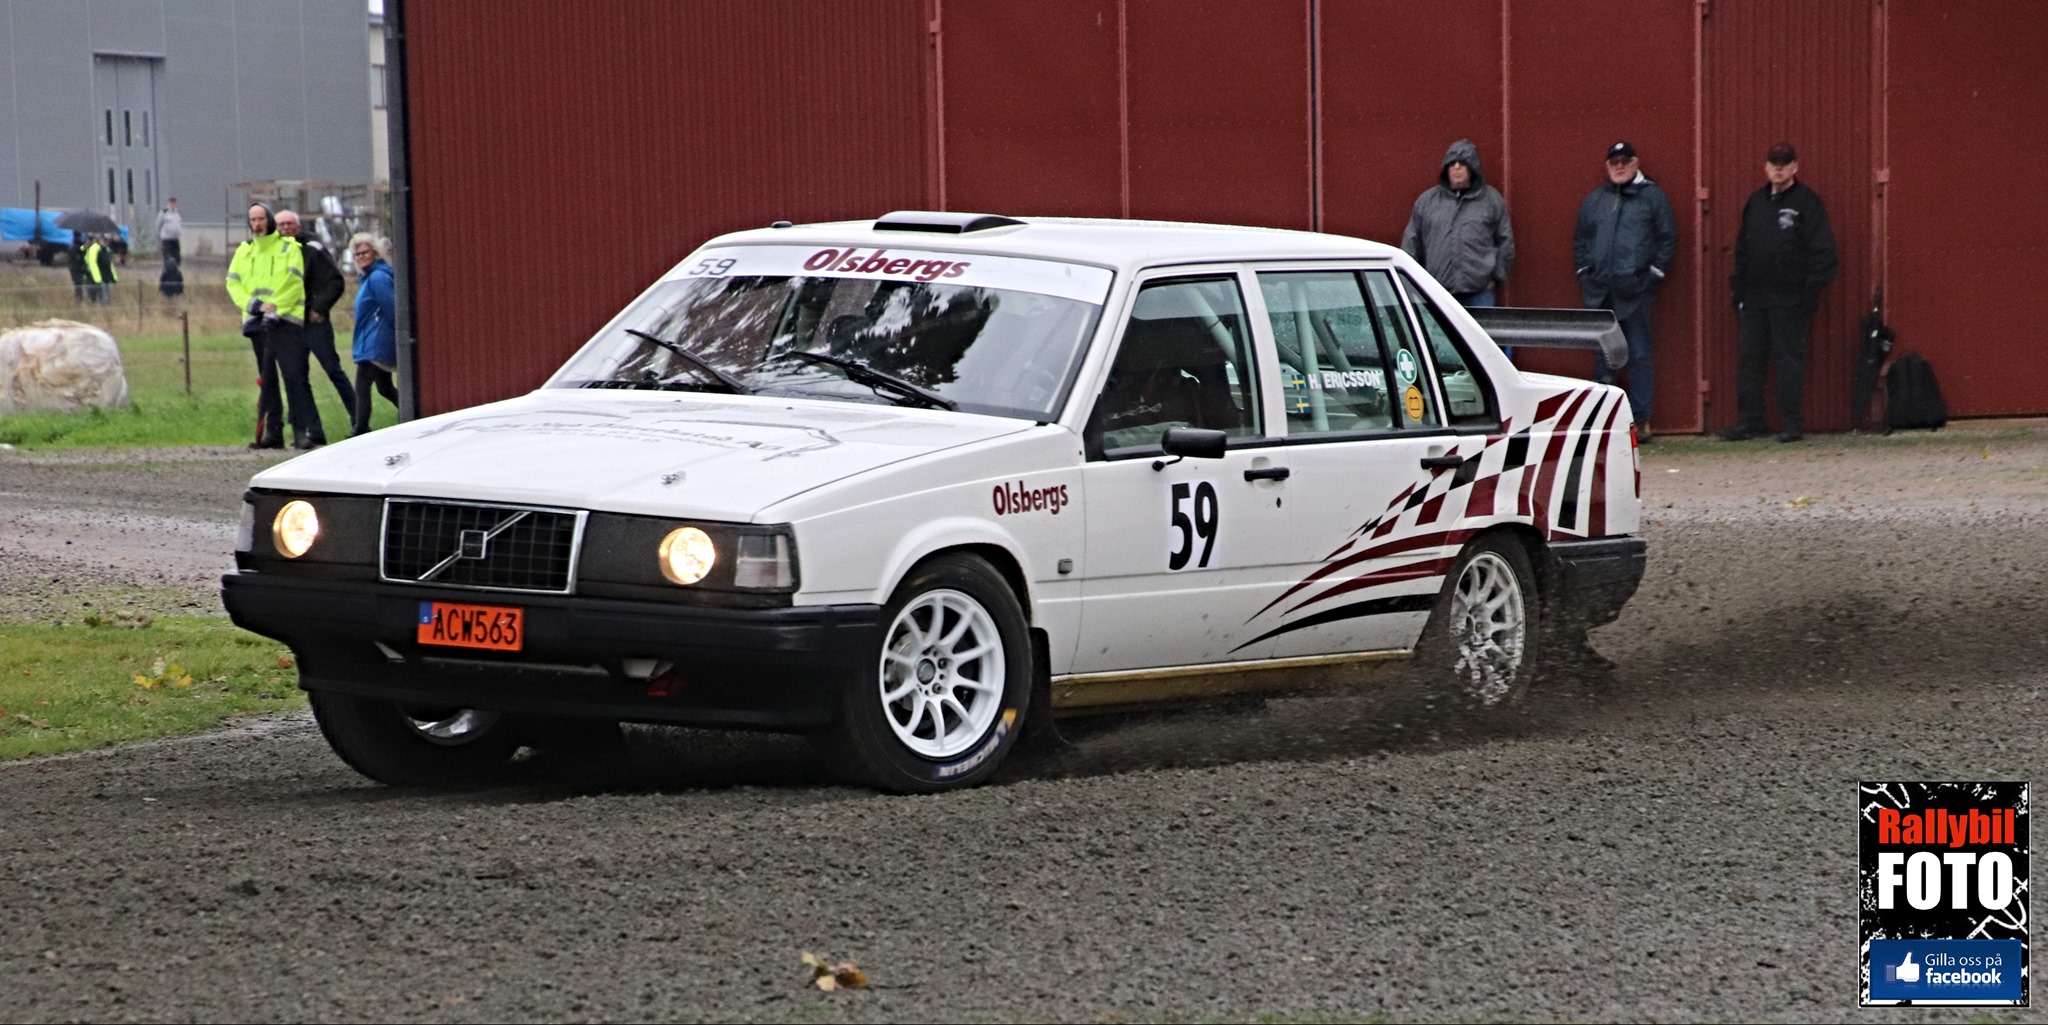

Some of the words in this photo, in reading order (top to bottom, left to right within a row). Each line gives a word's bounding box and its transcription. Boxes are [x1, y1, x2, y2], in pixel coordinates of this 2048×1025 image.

[688, 258, 738, 276] 59
[803, 247, 972, 281] Olsbergs
[1308, 374, 1322, 389] H.
[1323, 371, 1381, 389] ERICSSON
[992, 480, 1069, 515] Olsbergs
[1168, 481, 1219, 571] 59
[433, 607, 517, 645] ACW563
